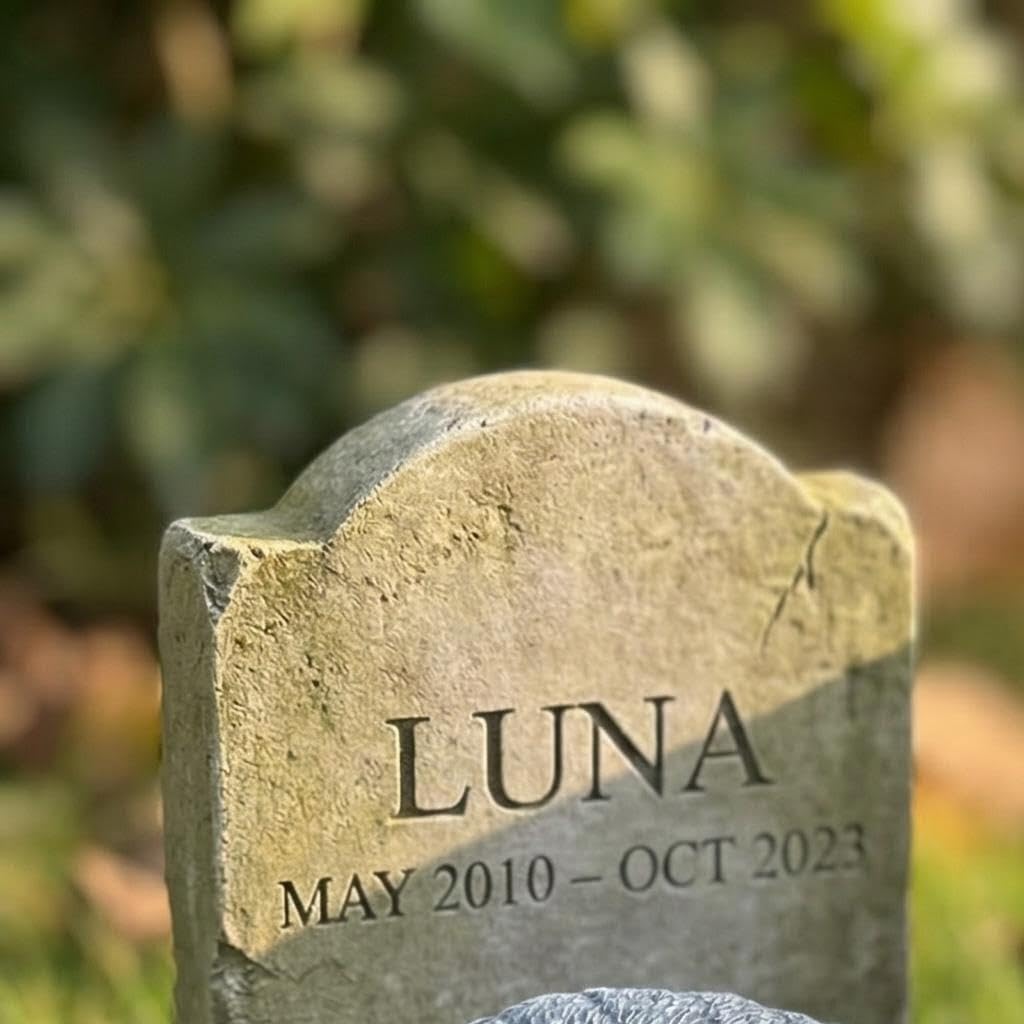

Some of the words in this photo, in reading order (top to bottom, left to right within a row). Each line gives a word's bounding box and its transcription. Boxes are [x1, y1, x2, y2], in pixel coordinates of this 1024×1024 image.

[385, 689, 774, 820] LUNA
[279, 868, 417, 929] MAY
[432, 855, 555, 912] 2010
[619, 836, 735, 893] OCT
[753, 823, 867, 880] 2023
